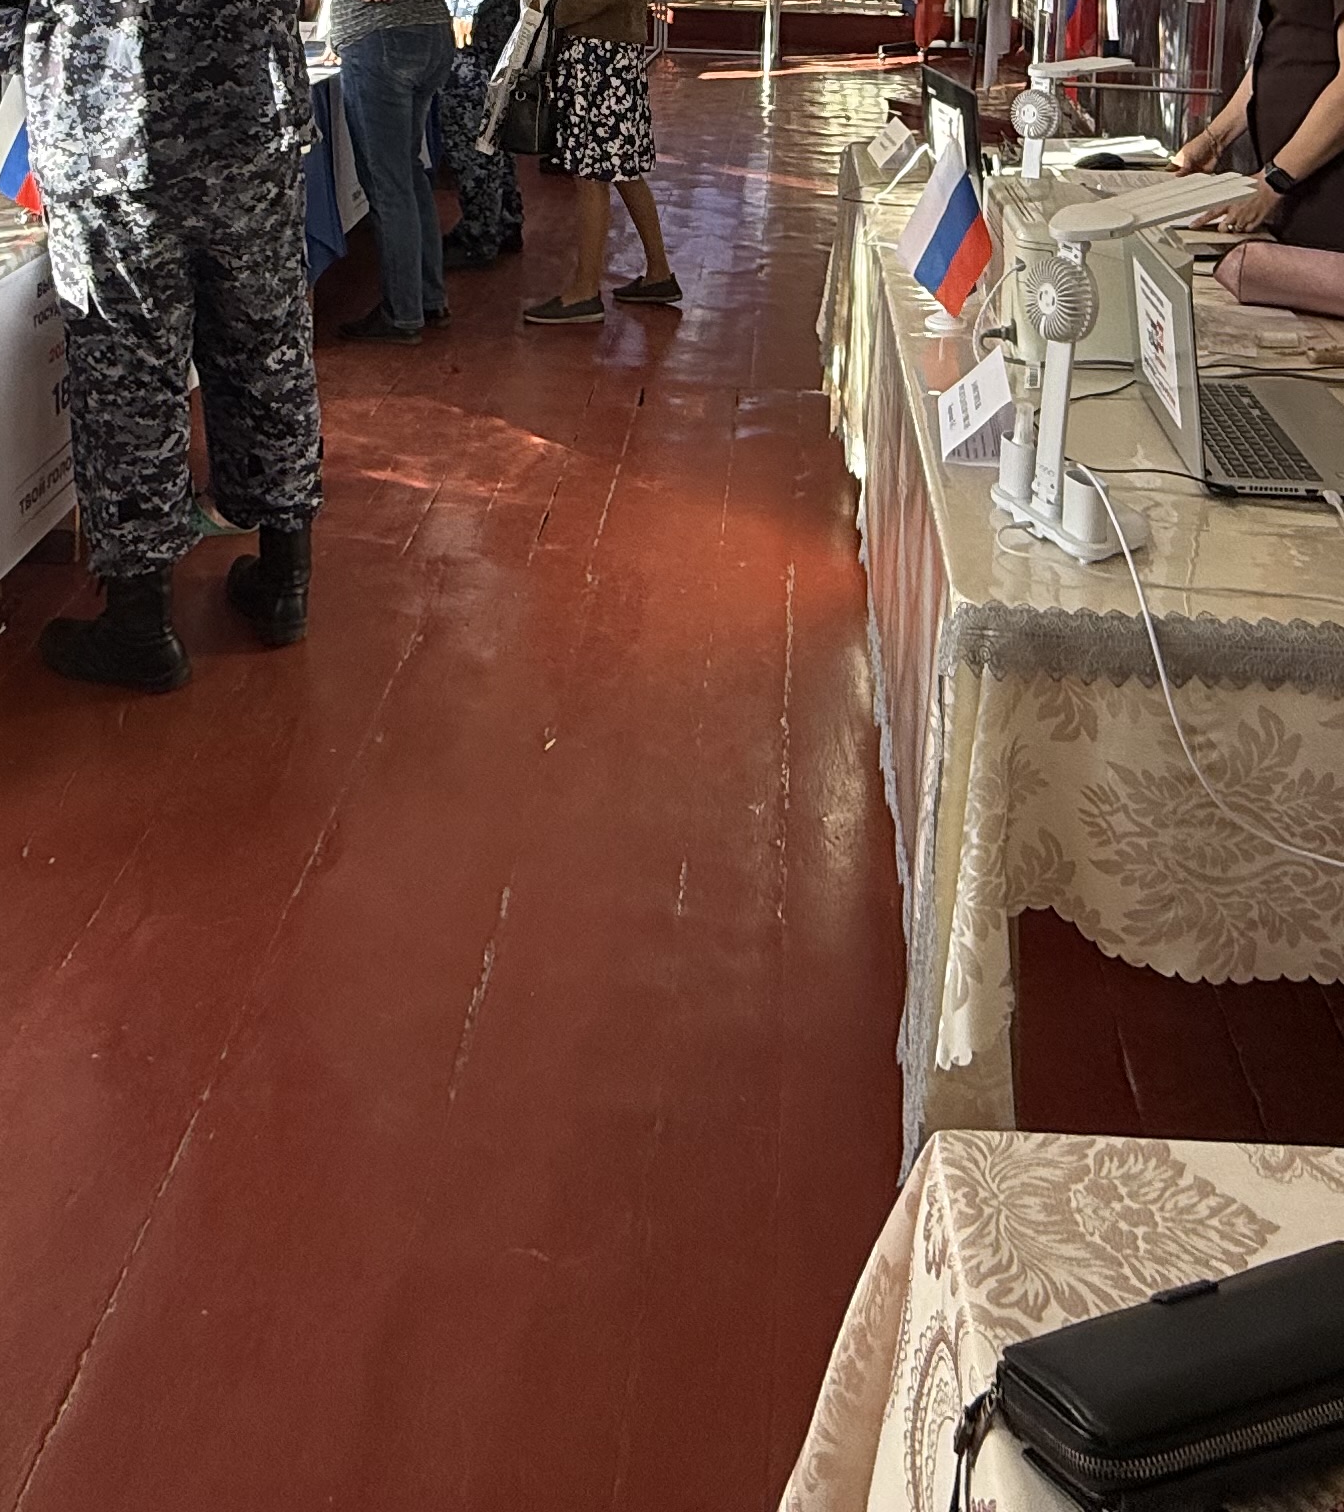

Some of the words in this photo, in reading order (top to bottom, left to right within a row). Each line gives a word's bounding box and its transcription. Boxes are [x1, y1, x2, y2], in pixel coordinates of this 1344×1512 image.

[51, 374, 71, 417] 18
[18, 476, 46, 516] ТВОЙ
[46, 455, 73, 489] ГОЛО
